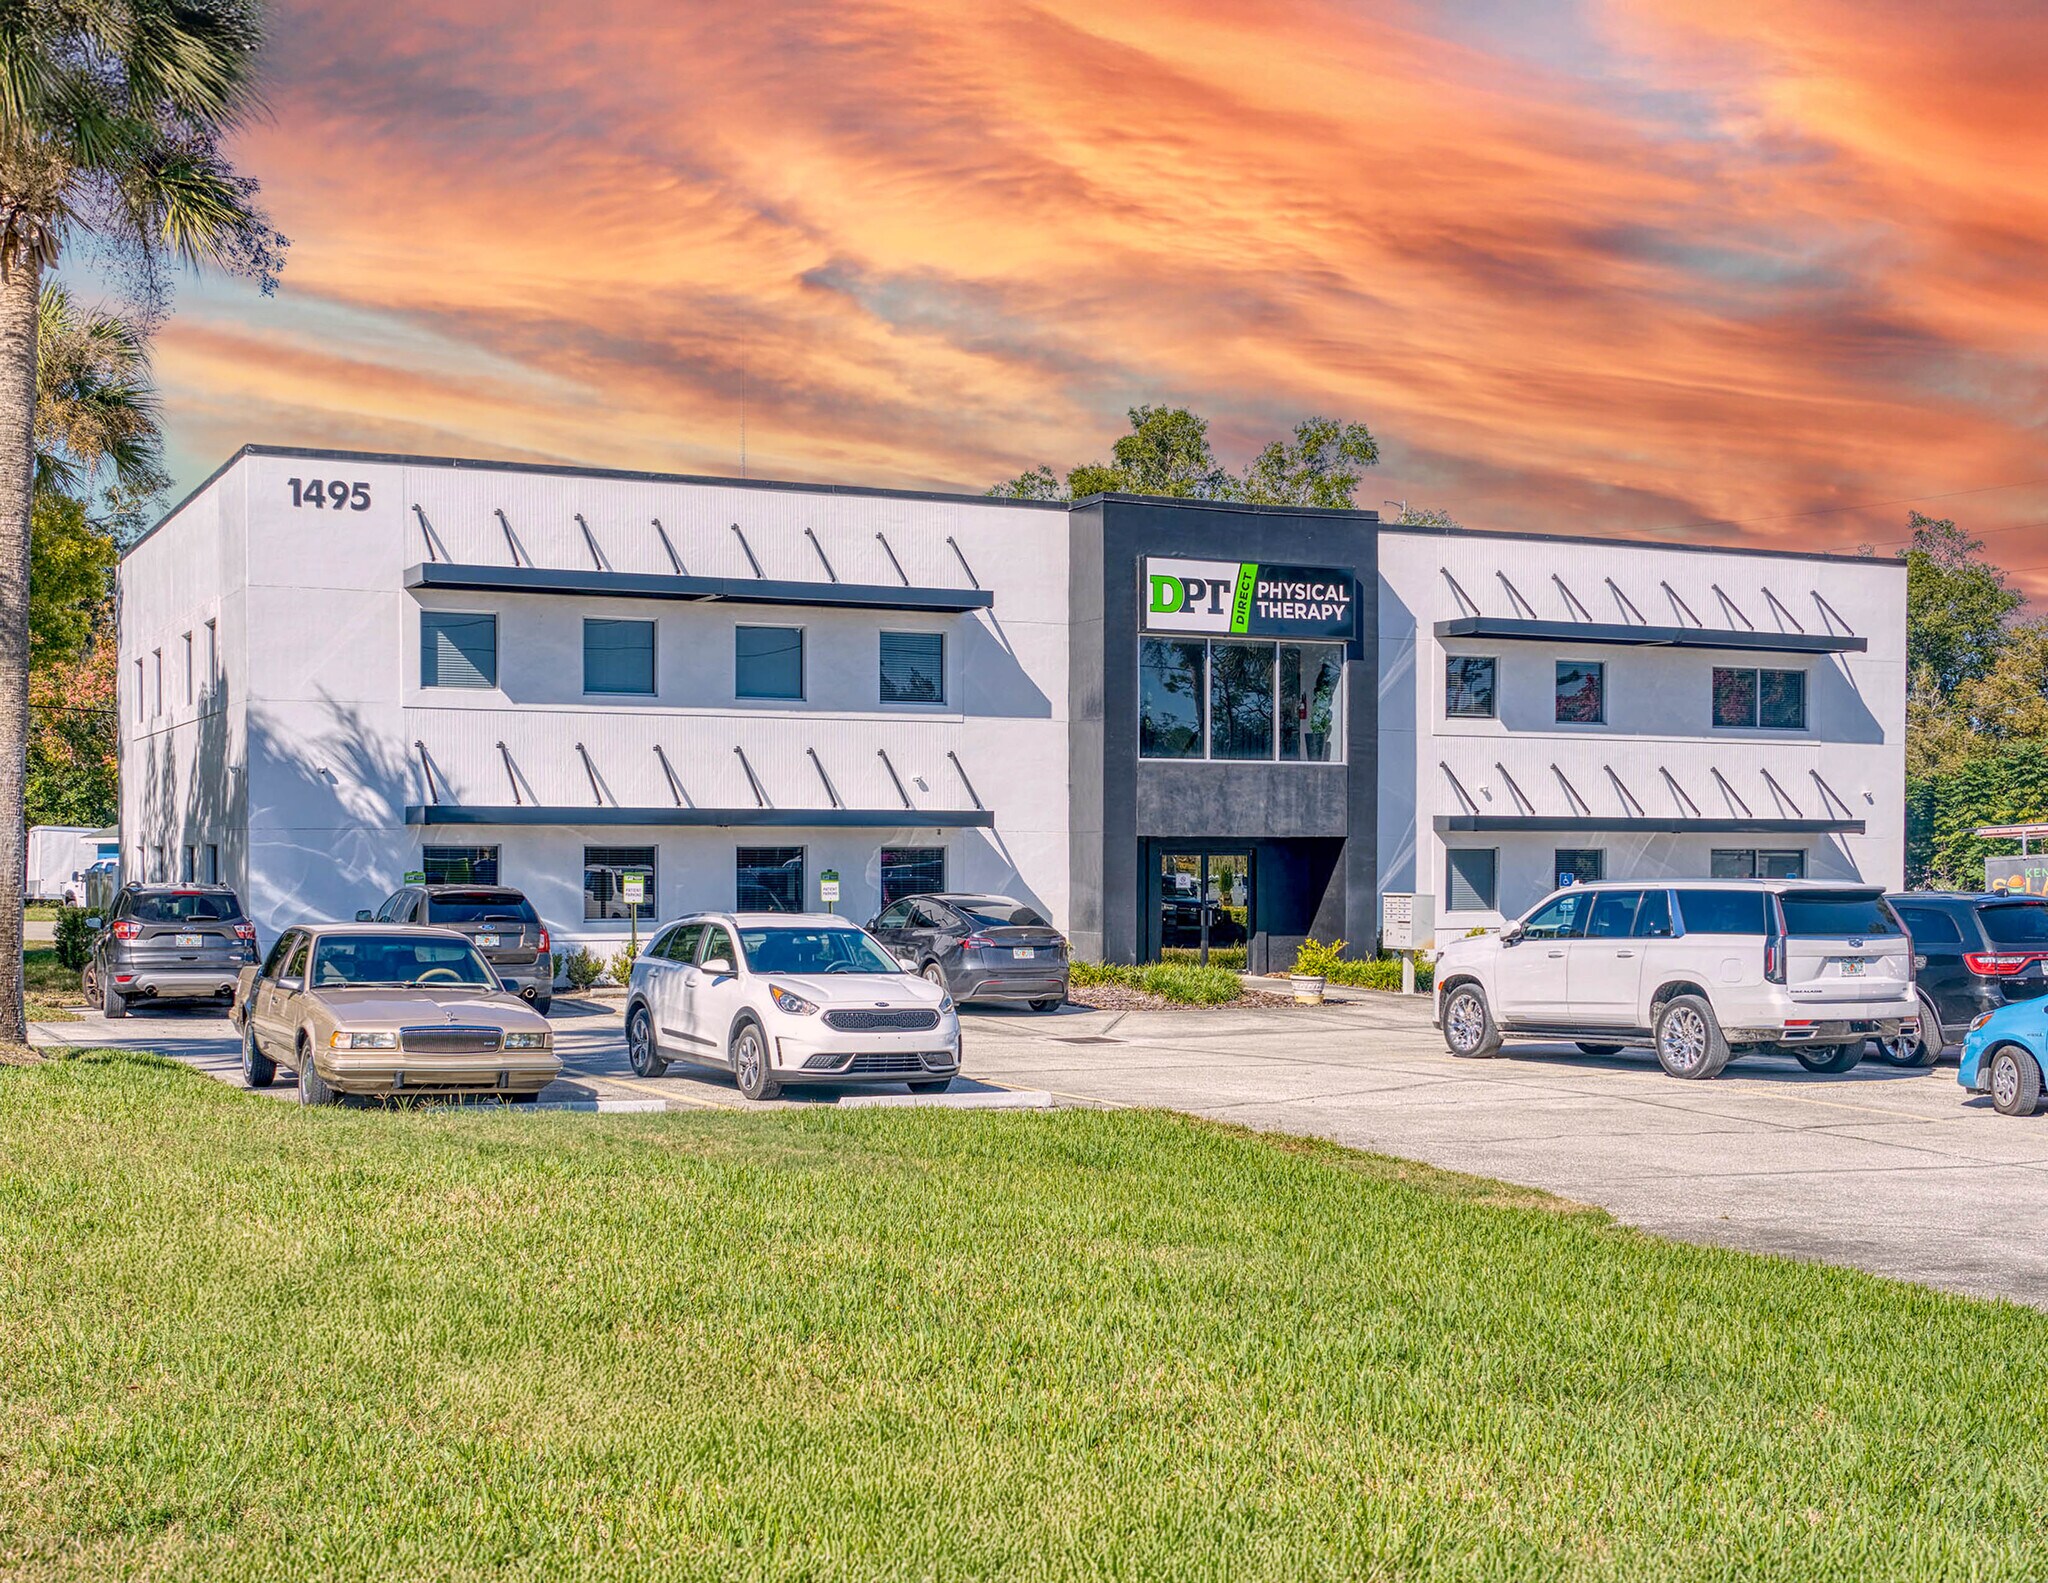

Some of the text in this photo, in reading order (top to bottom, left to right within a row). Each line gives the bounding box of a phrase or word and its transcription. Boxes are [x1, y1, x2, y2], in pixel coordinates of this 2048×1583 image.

[287, 477, 371, 511] 1495
[1149, 574, 1231, 615] DPT
[1236, 572, 1253, 625] DIRECT
[1257, 581, 1350, 602] PHYSICAL
[1257, 601, 1346, 621] THERAPY
